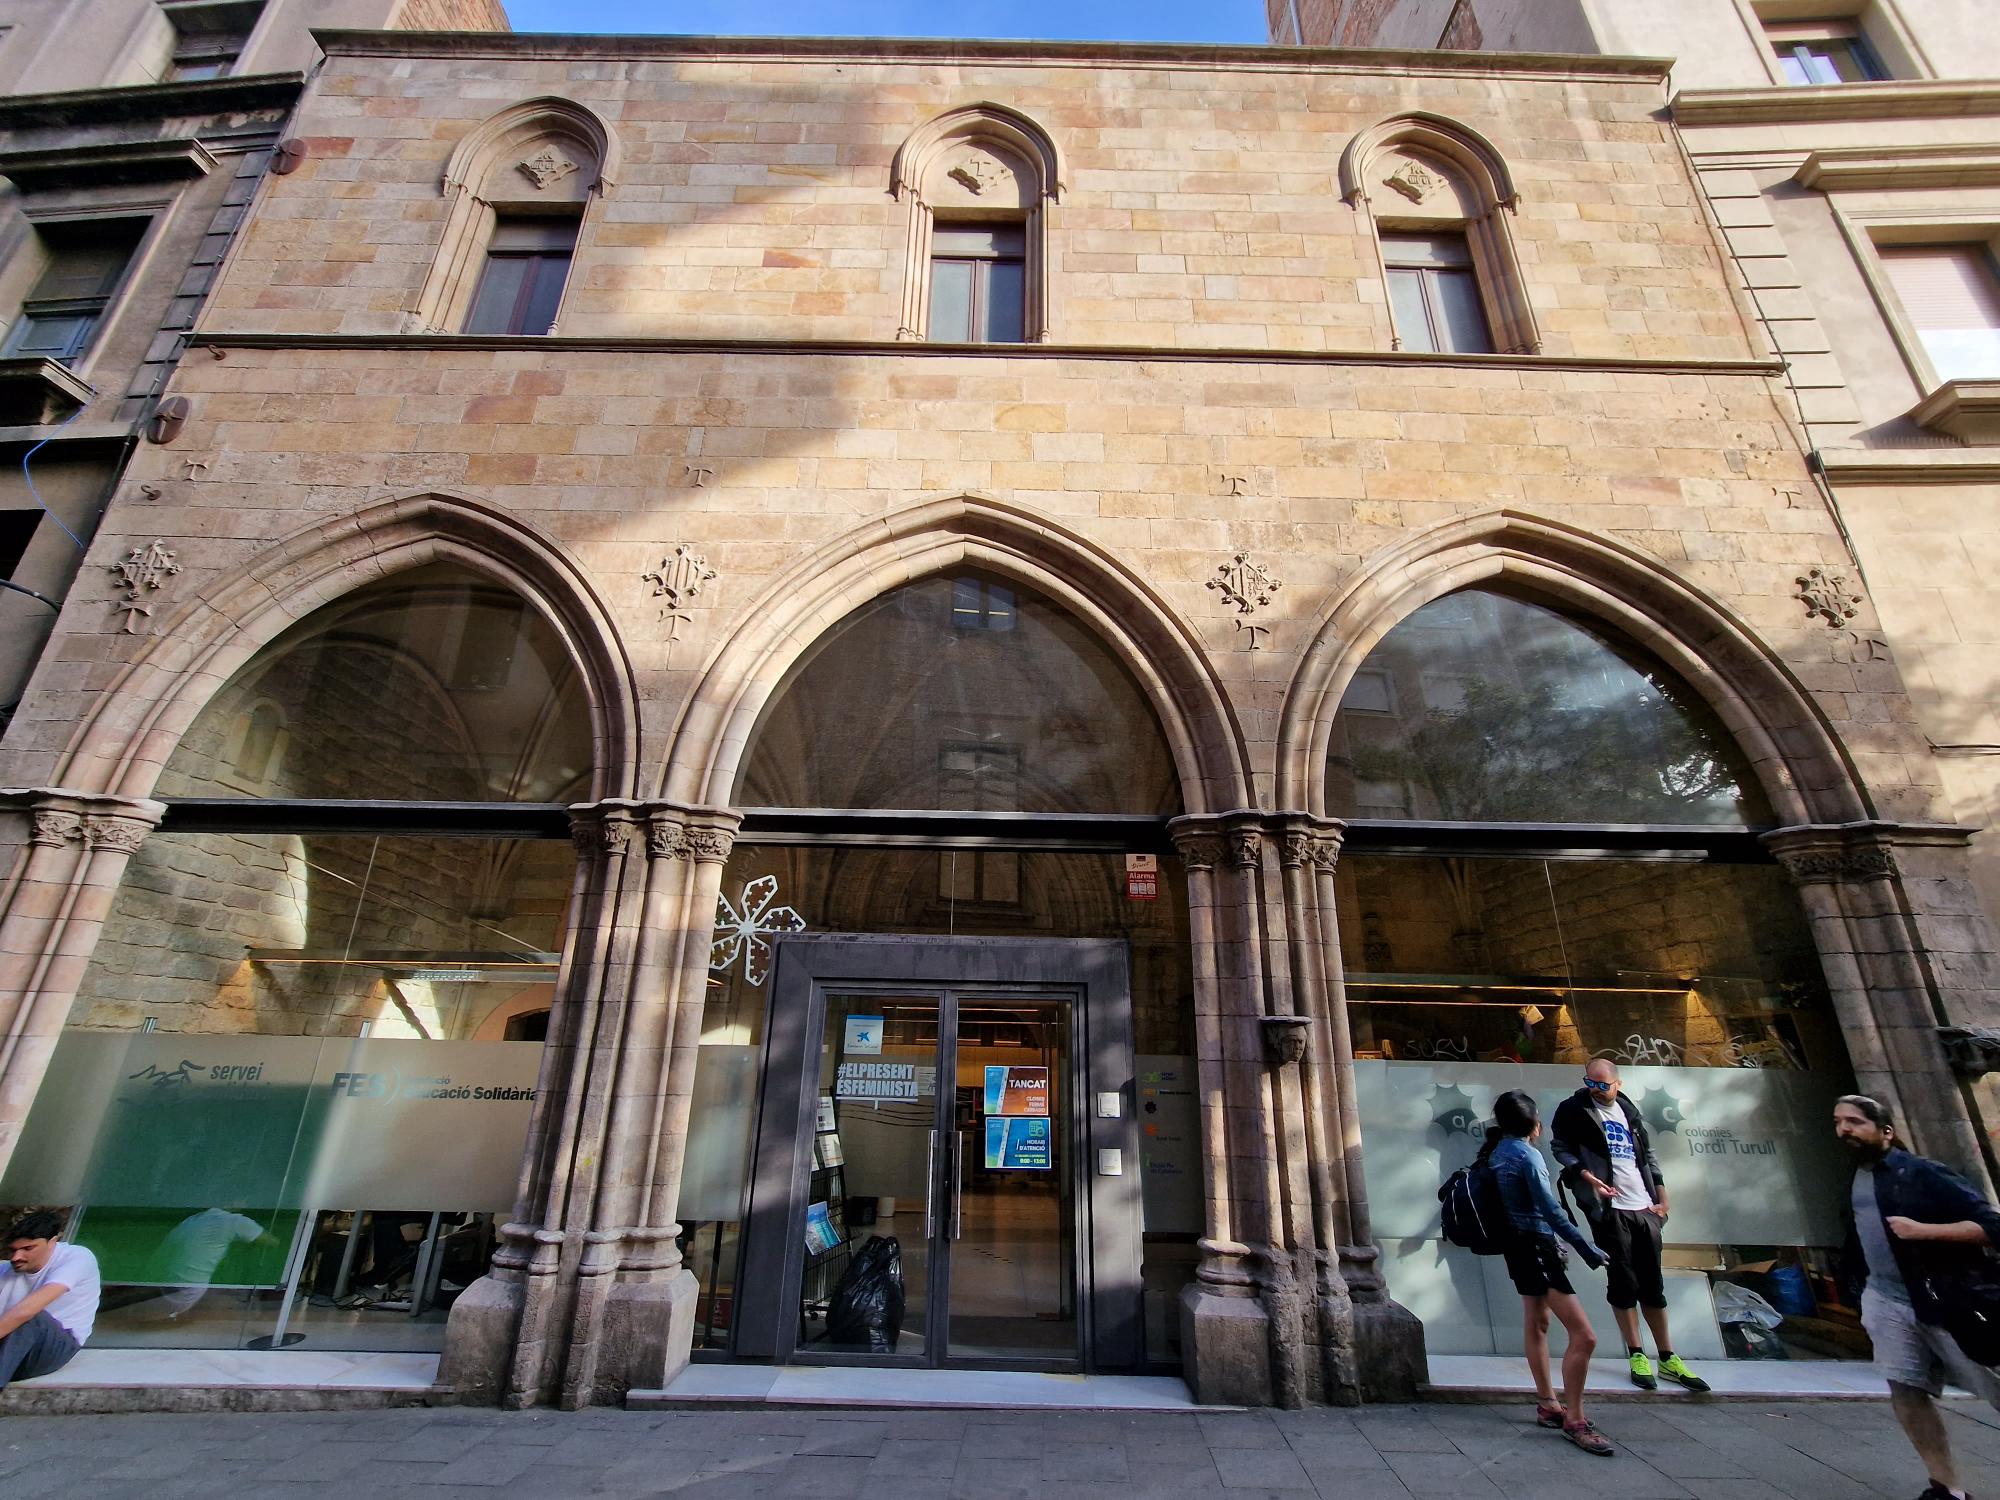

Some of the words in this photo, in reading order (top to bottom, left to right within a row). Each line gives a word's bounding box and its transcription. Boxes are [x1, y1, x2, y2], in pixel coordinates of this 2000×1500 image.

[1129, 872, 1156, 880] Alarma
[210, 1062, 264, 1080] servei
[837, 1062, 915, 1080] #ELPRESENT
[404, 1084, 471, 1101] Ecació
[1009, 1079, 1046, 1089] TANCAT
[1688, 1139, 1728, 1156] Jordi
[1730, 1139, 1777, 1155] Turull
